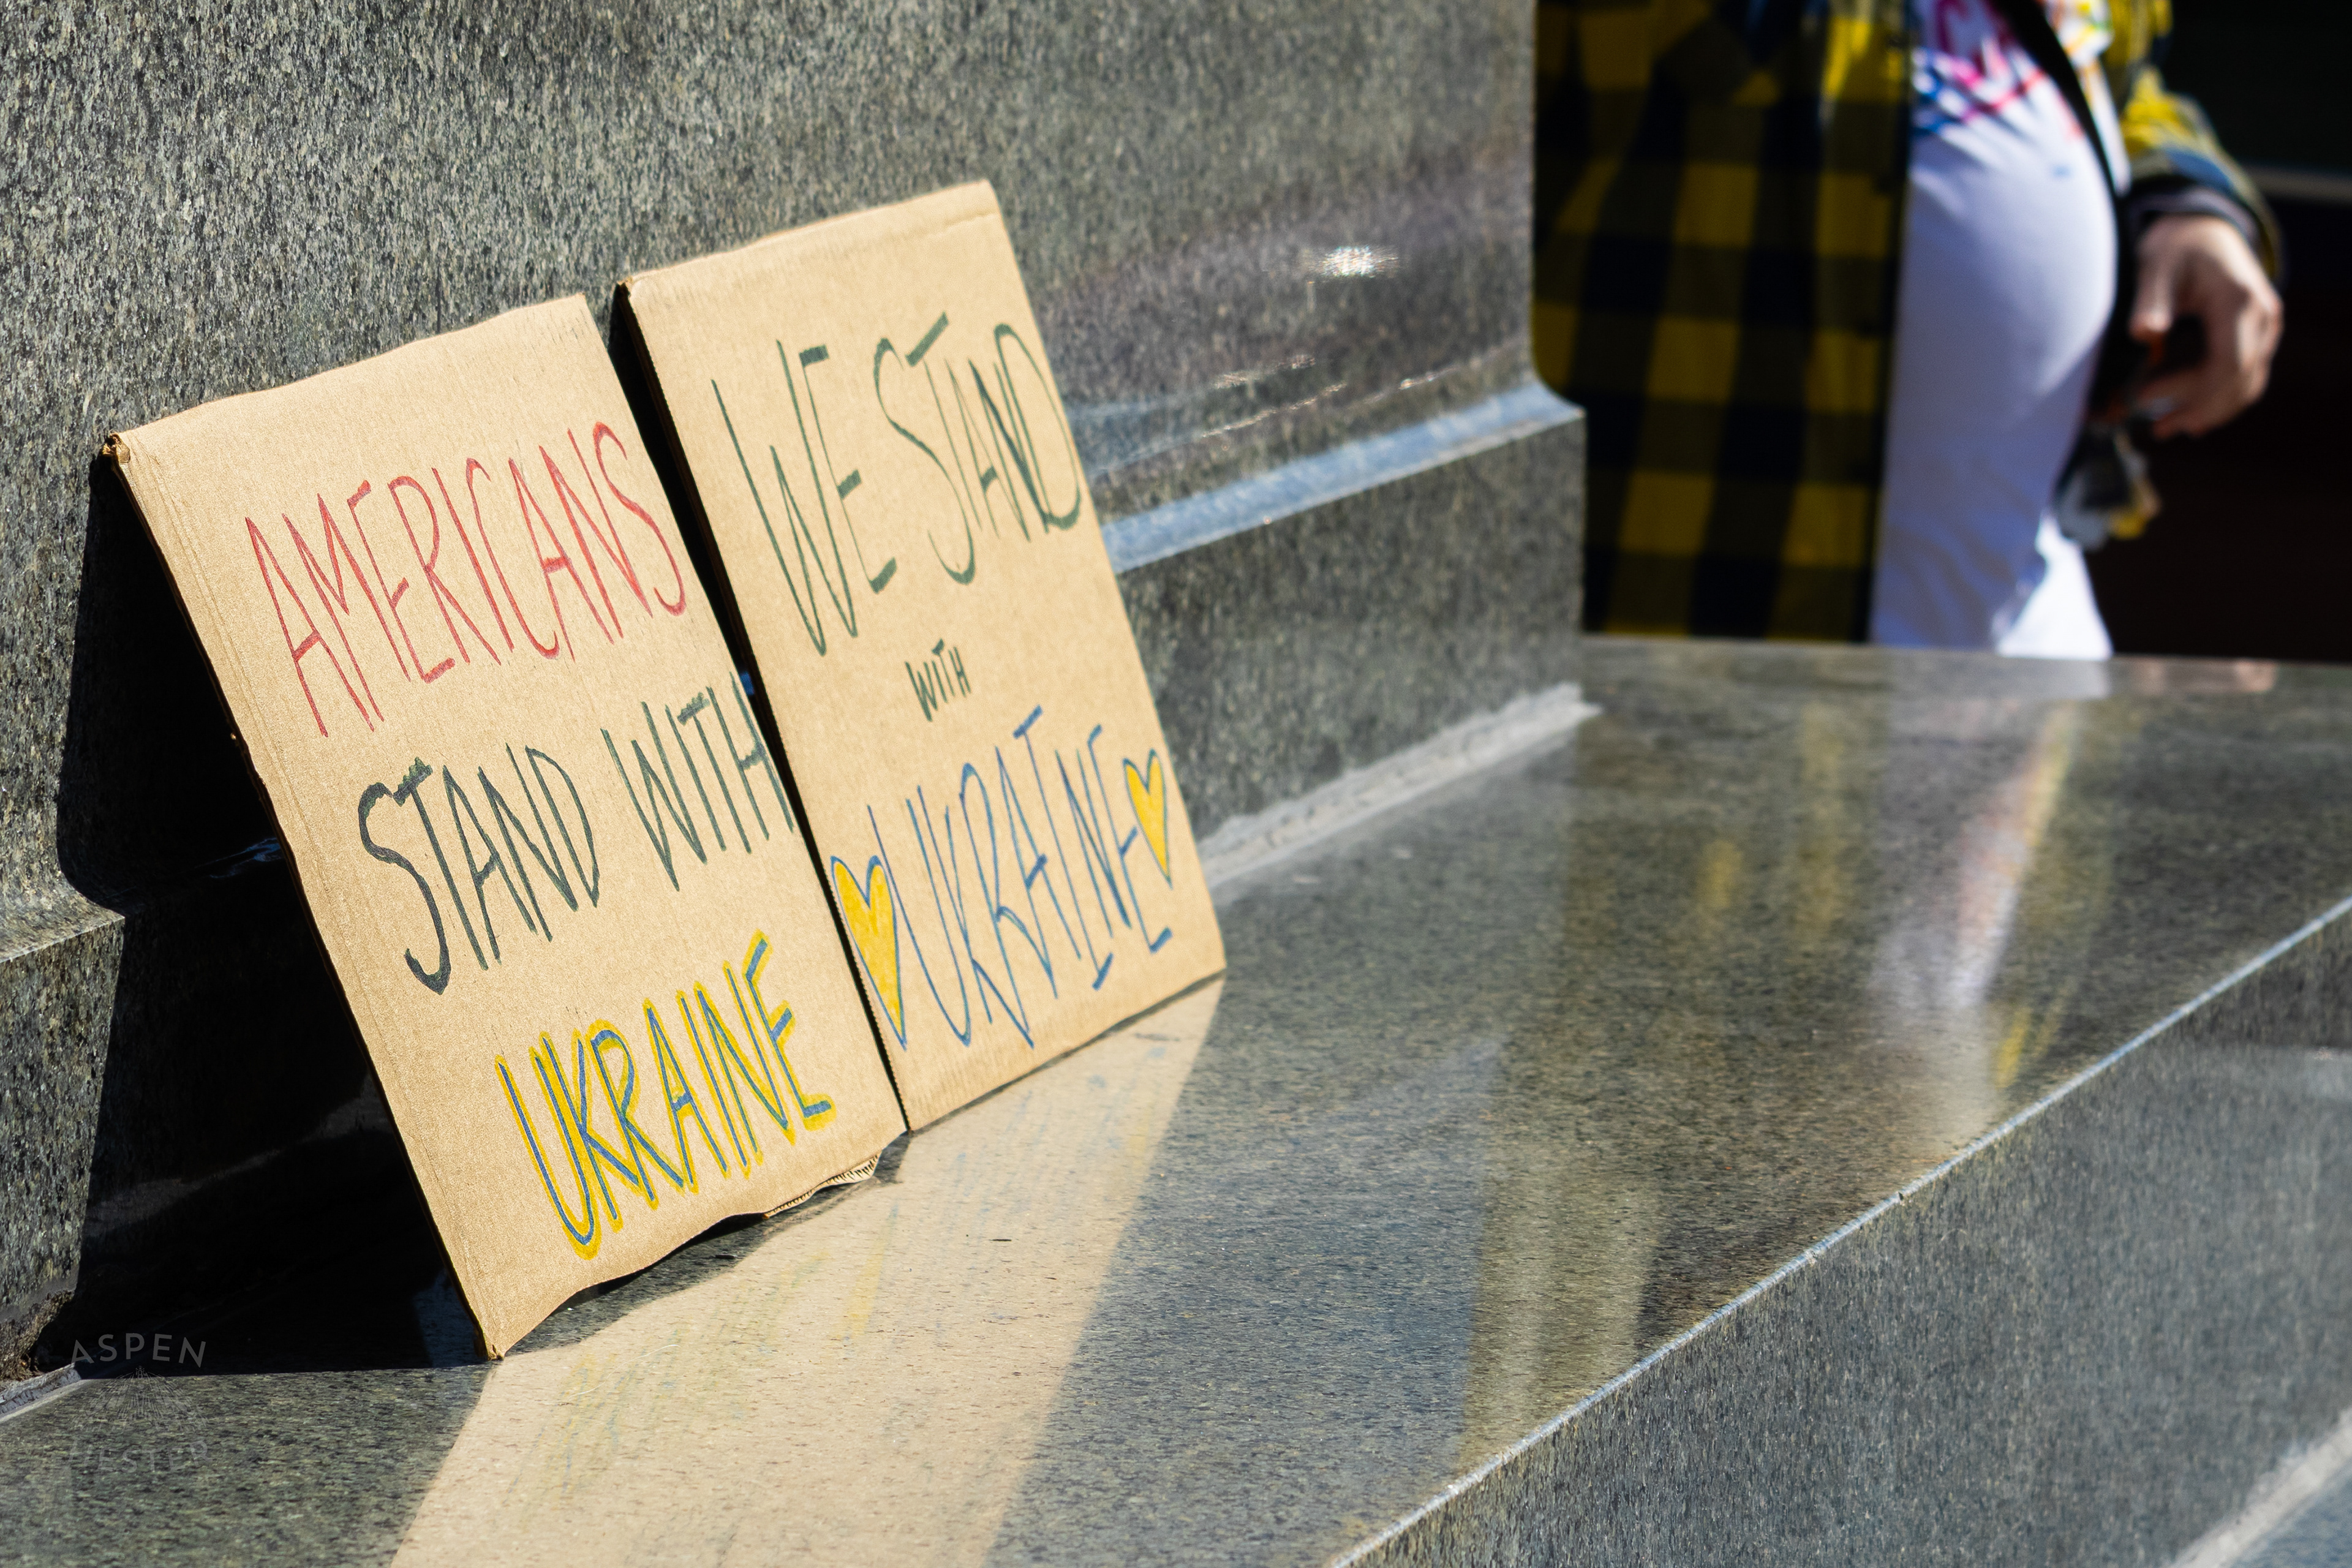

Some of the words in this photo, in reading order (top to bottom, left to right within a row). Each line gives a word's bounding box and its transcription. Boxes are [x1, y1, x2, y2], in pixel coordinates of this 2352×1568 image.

[246, 421, 685, 736] AMERICANS
[711, 339, 897, 657] WE
[873, 312, 1082, 586] STAND
[358, 742, 600, 994] STAND
[600, 672, 794, 891] WITH
[905, 638, 972, 722] WITH
[867, 704, 1173, 1050] UKRAINE
[494, 929, 837, 1259] UKRAINE
